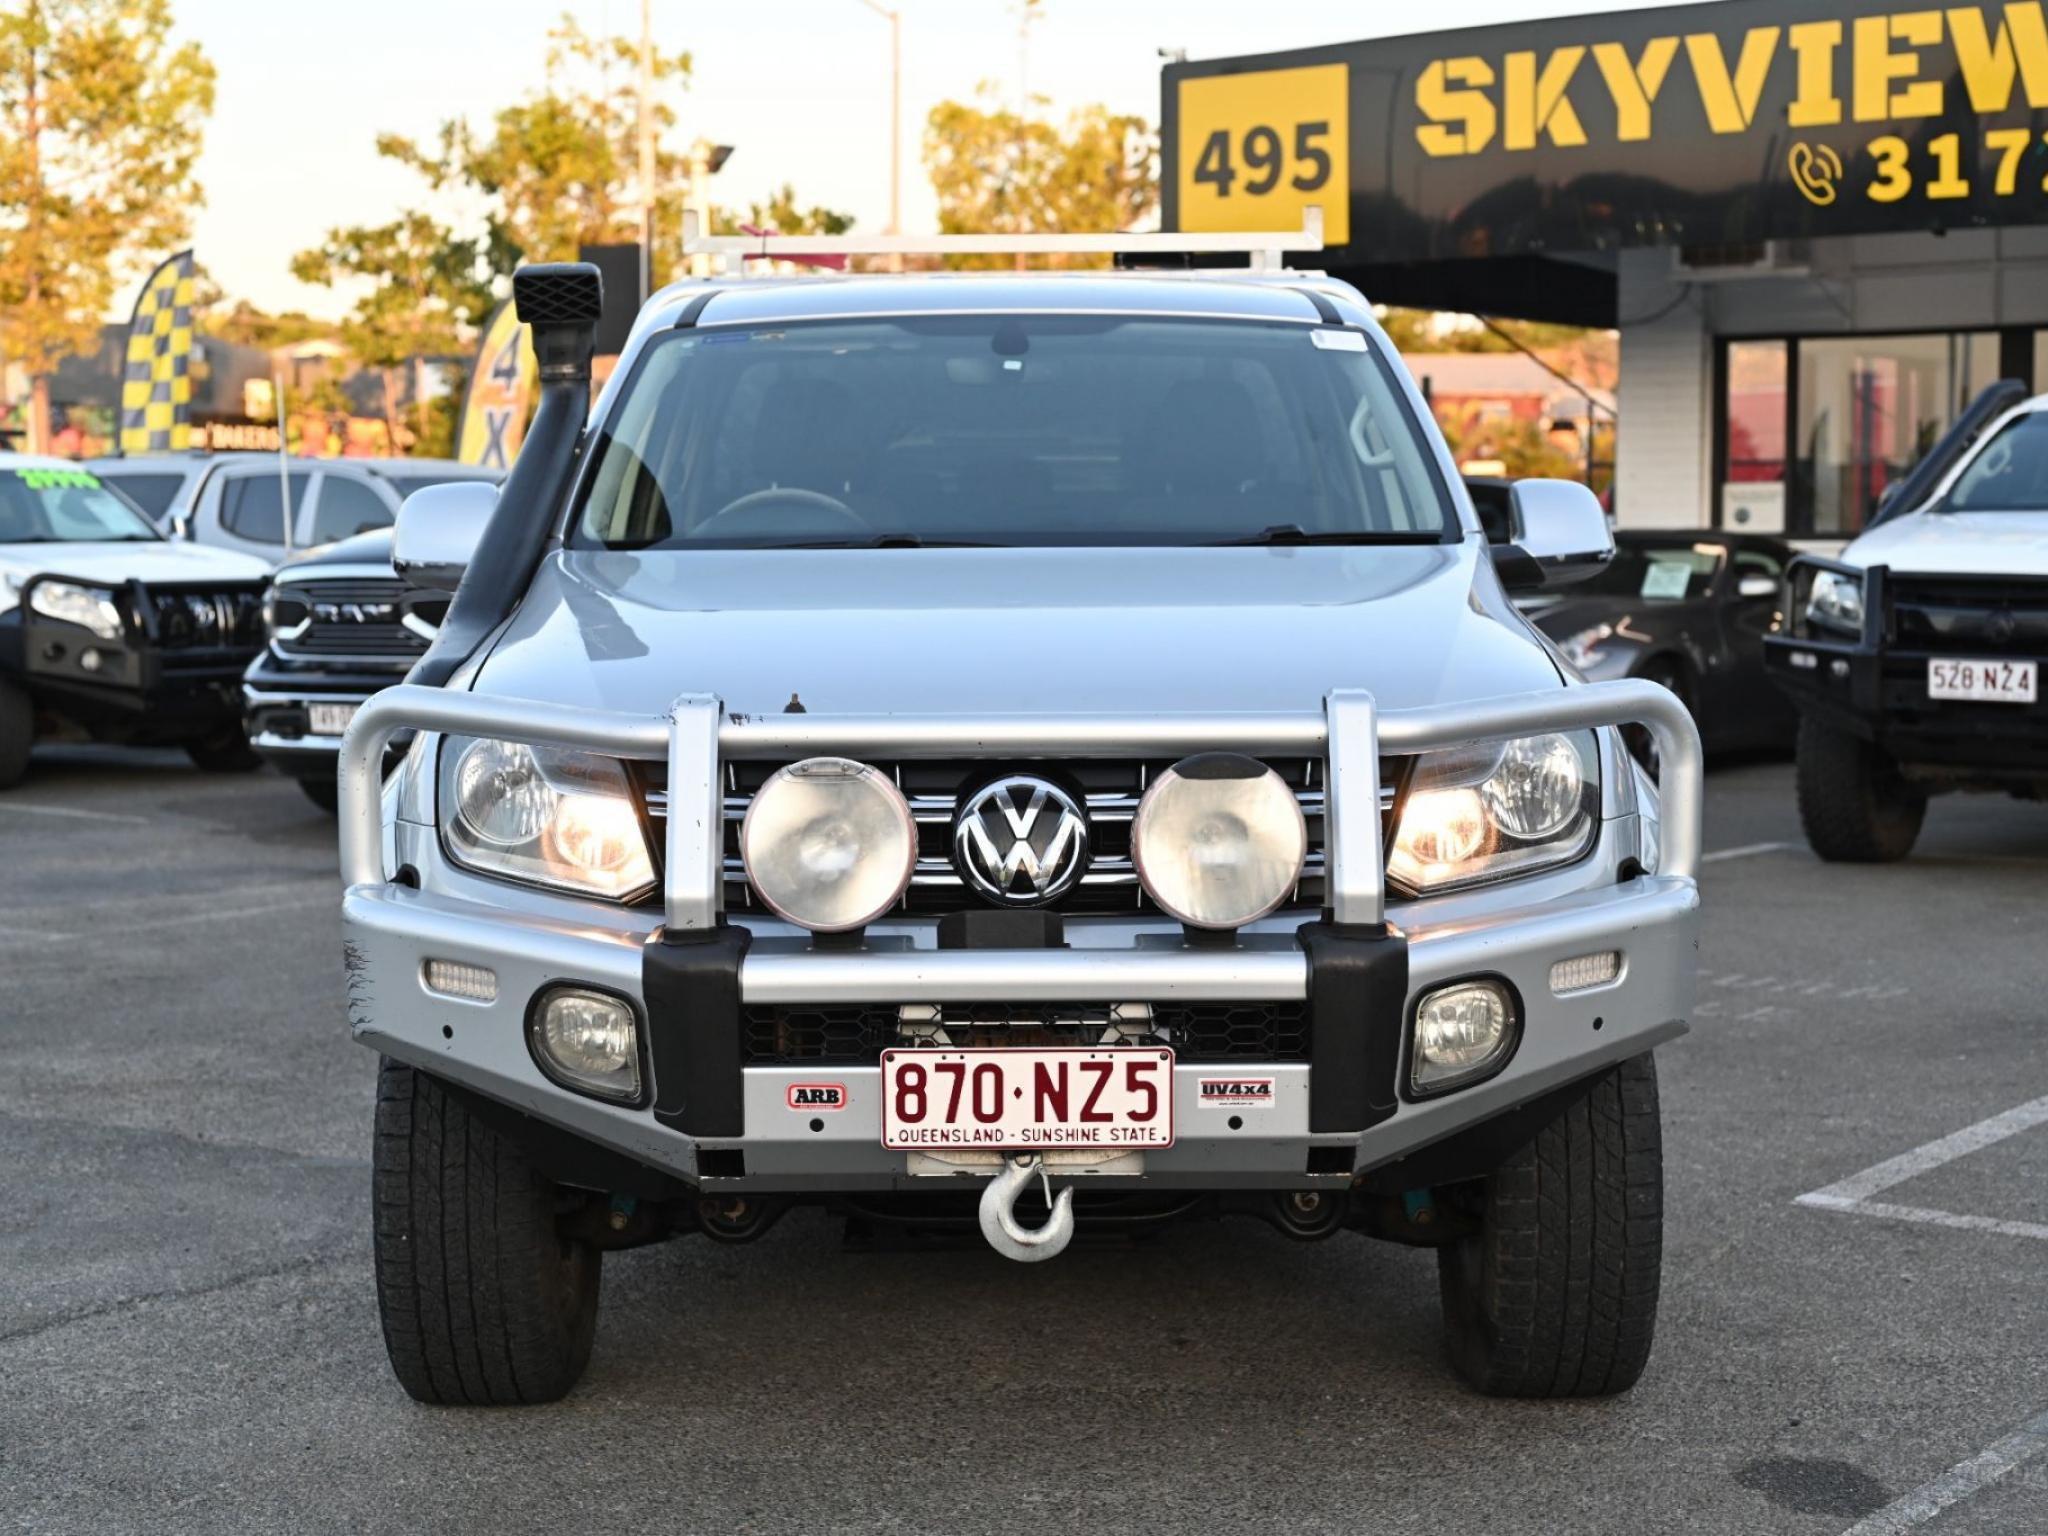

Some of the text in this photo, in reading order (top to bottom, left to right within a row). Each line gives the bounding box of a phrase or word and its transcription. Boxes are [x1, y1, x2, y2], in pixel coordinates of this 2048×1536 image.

[1415, 0, 2048, 157] SKYVIEW
[1193, 121, 1332, 197] 495
[1867, 127, 2048, 203] 317
[795, 1088, 840, 1104] ARB
[1202, 1084, 1270, 1095] UV4x4
[899, 1129, 1004, 1142] QUEENSLAND
[1021, 1128, 1101, 1142] SUNSHINE
[1110, 1127, 1157, 1141] STATE
